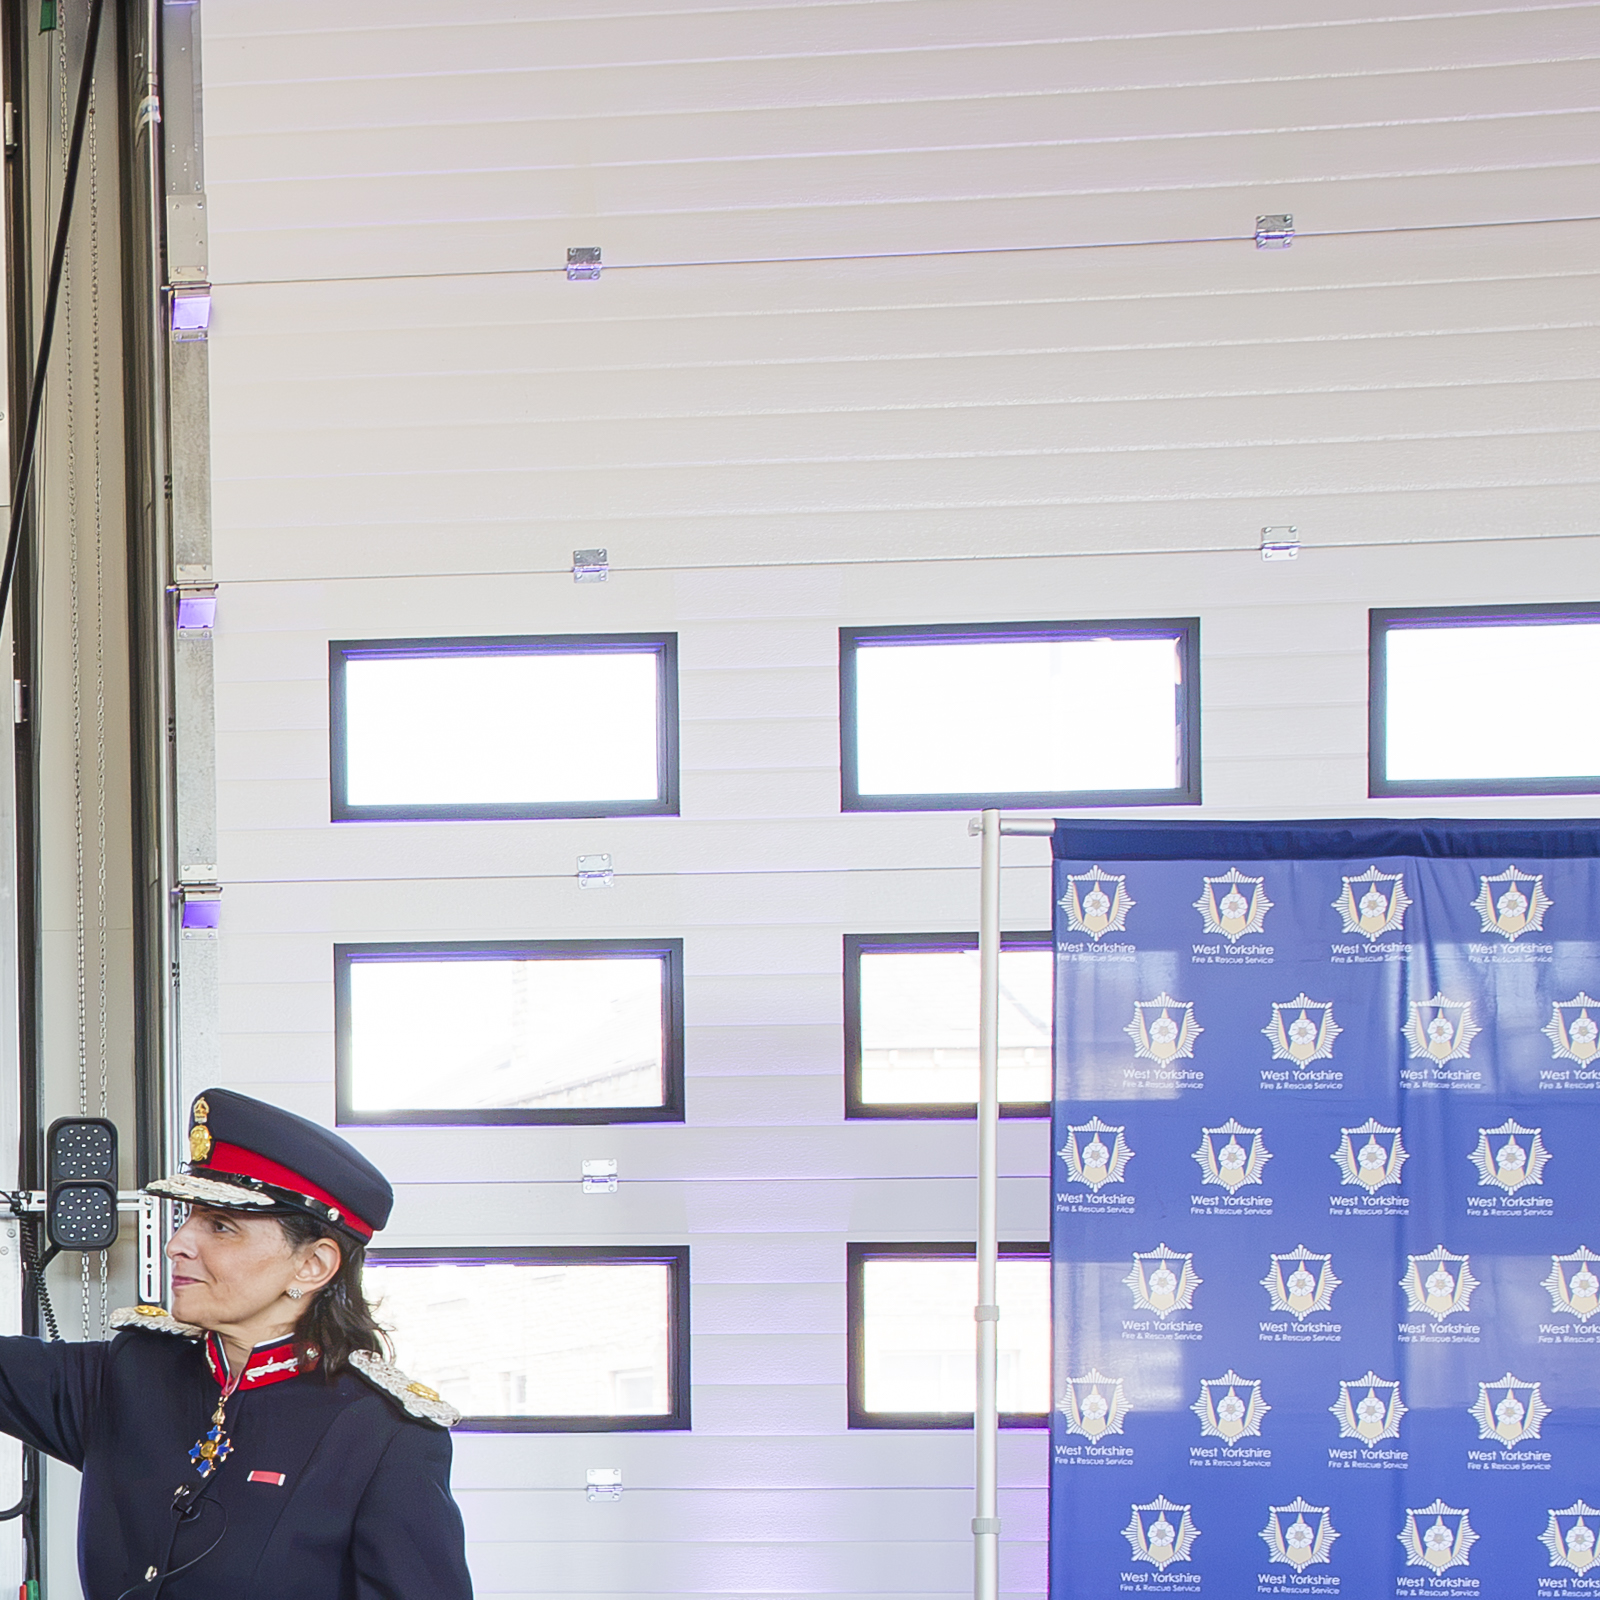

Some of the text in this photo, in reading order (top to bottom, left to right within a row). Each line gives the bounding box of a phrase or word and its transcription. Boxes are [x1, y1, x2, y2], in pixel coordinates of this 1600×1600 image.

[1056, 941, 1136, 953] West Yorkshire
[1192, 944, 1274, 955] West Yorkshire
[1331, 942, 1413, 954] West Yorkshire
[1467, 942, 1554, 954] West Yorkshire
[1123, 1069, 1205, 1080] West Yorkshire
[1260, 1070, 1344, 1081] West Yorkshire
[1399, 1069, 1482, 1081] West Yorkshire
[1539, 1070, 1569, 1081] West
[1056, 1193, 1136, 1205] West Yorkshire
[1190, 1195, 1274, 1206] West Yorkshire
[1329, 1195, 1410, 1207] West Yorkshire
[1466, 1196, 1554, 1208] West Yorkshire
[1121, 1320, 1204, 1332] West Yorkshire
[1259, 1322, 1342, 1333] West Yorkshire
[1397, 1323, 1481, 1334] West Yorkshire
[1538, 1323, 1568, 1335] West
[1054, 1445, 1134, 1457] West Yorkshire
[1189, 1447, 1272, 1458] West Yorkshire
[1328, 1448, 1409, 1460] West Yorkshire
[1467, 1450, 1552, 1461] West Yorkshire
[1120, 1572, 1202, 1583] West Yorkshire
[1257, 1573, 1341, 1585] West Yorkshire
[1396, 1576, 1480, 1588] West Yorkshire
[1537, 1577, 1567, 1589] West
